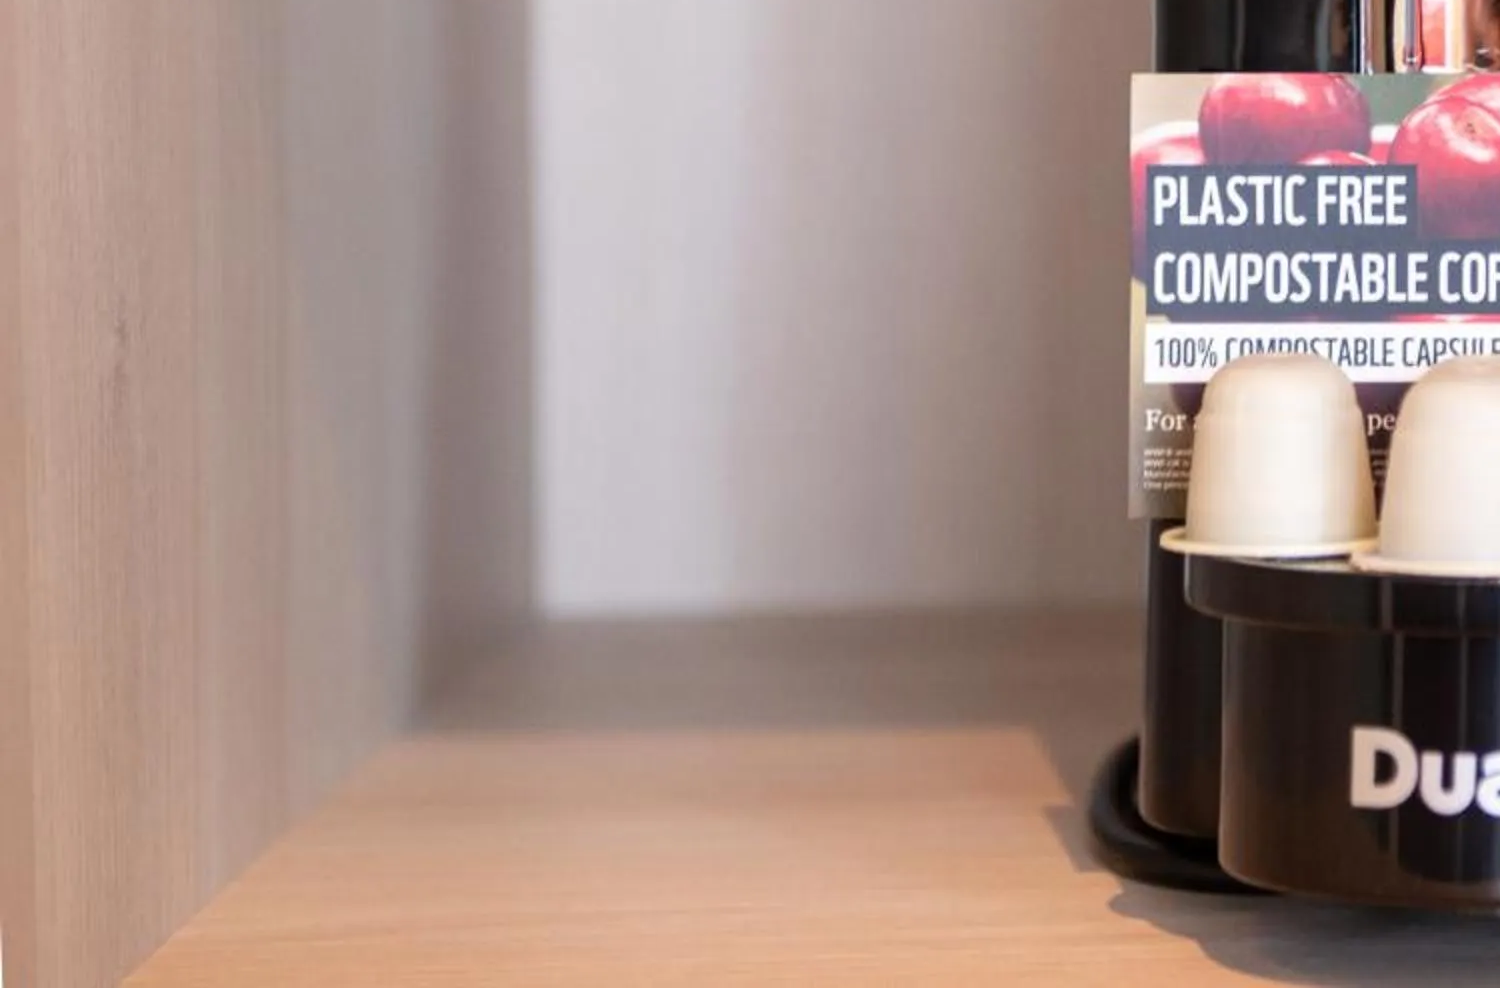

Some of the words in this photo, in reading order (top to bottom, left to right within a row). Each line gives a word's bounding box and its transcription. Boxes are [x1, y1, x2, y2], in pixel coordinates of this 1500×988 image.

[1153, 175, 1307, 226] PLASTIC
[1317, 175, 1407, 226] FREE
[1153, 252, 1429, 304] COMPOSTABLE
[1155, 337, 1218, 368] 100%
[1145, 409, 1187, 432] For
